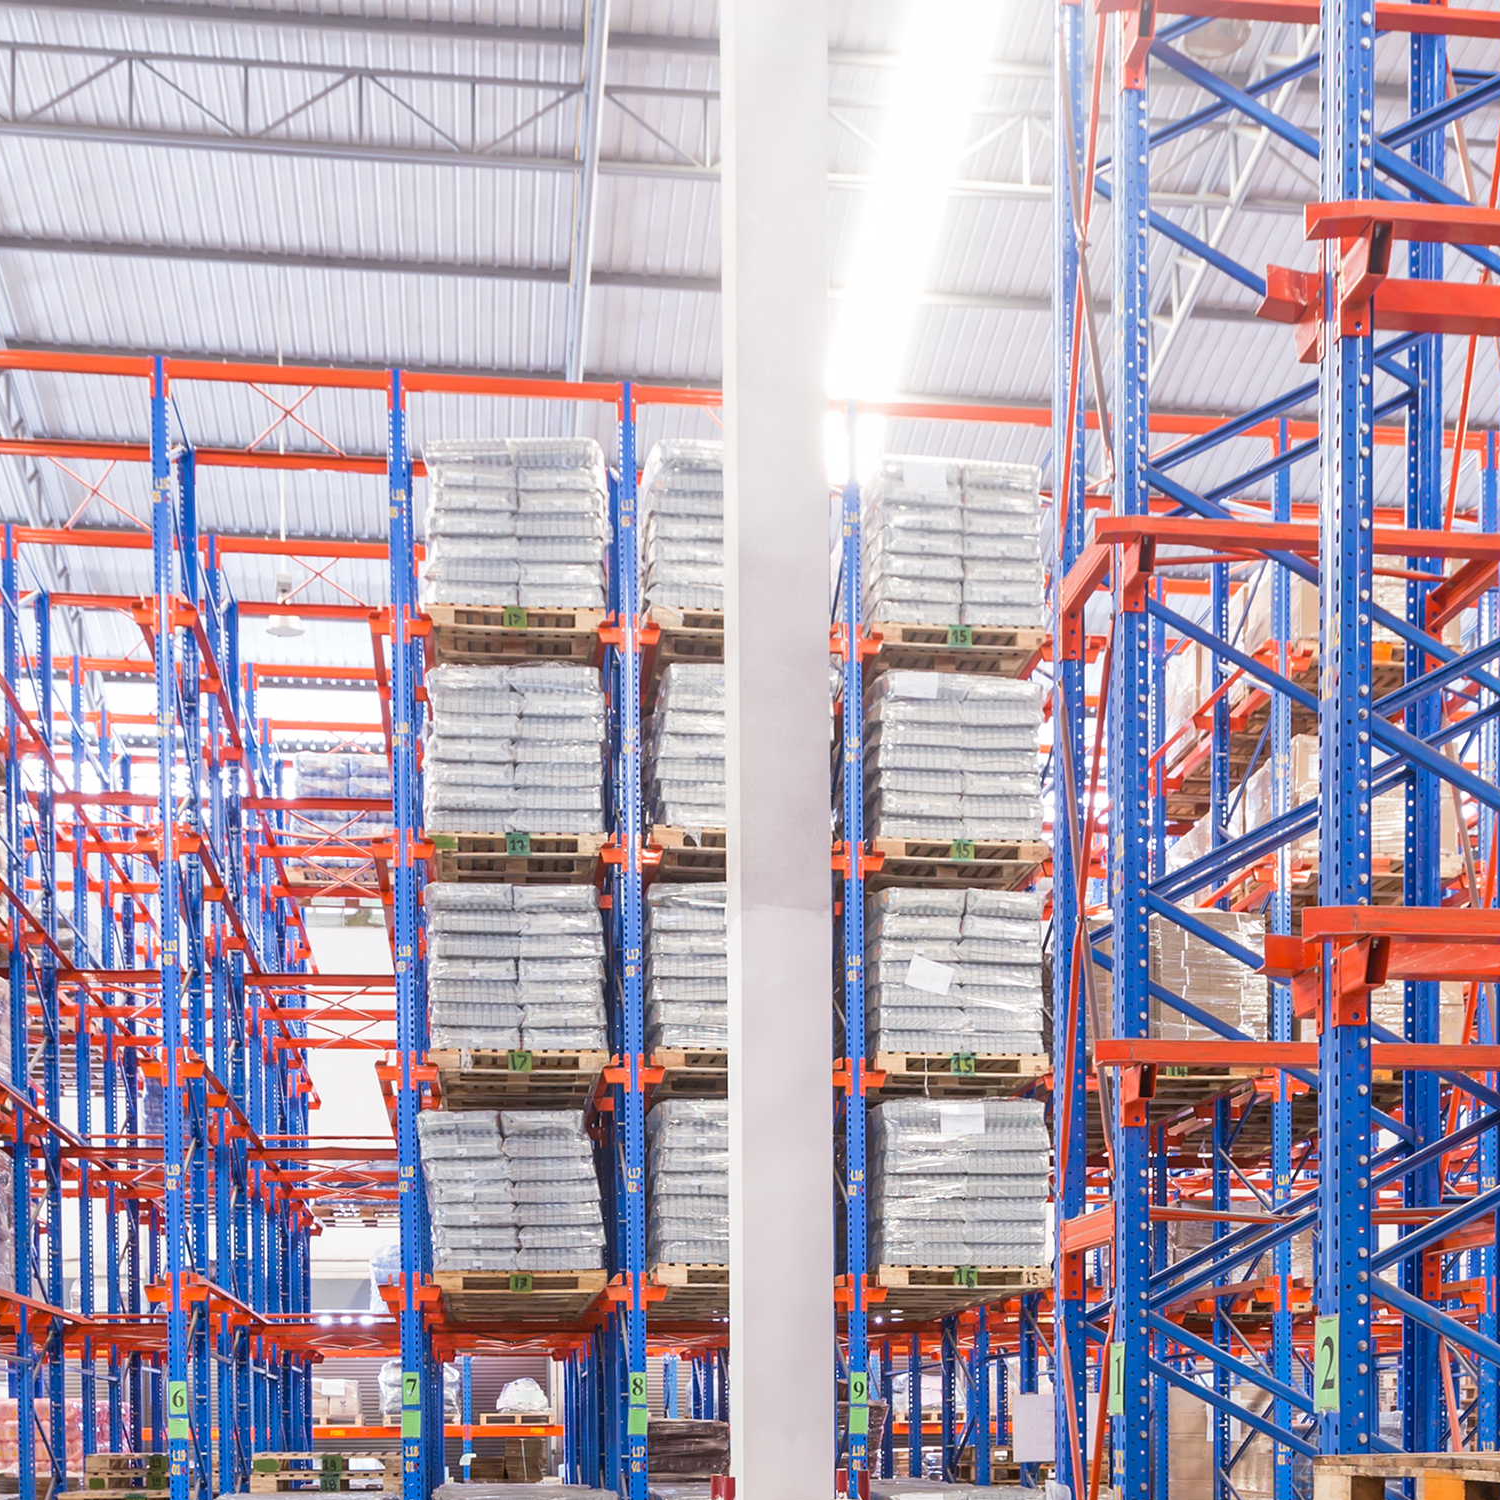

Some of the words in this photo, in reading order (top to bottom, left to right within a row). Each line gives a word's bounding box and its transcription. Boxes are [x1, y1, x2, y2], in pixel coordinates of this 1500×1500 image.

[952, 630, 967, 643] 15
[626, 948, 640, 960] L17
[511, 1054, 527, 1071] 17
[952, 1056, 973, 1073] 15
[166, 1163, 180, 1176] L19
[400, 1165, 414, 1178] L18
[628, 1167, 642, 1179] L17
[850, 1169, 864, 1181] L16
[1277, 1174, 1290, 1186] L14
[399, 1181, 409, 1193] 02
[627, 1181, 637, 1193] 02
[956, 1269, 975, 1287] 15
[1321, 1336, 1335, 1390] 2
[1115, 1356, 1122, 1395] 1
[405, 1378, 417, 1396] 7
[632, 1378, 644, 1396] 8
[853, 1381, 865, 1399] 9
[172, 1389, 184, 1408] 6
[173, 1449, 186, 1461] L19
[405, 1446, 419, 1458] L18
[632, 1446, 645, 1458] L17
[852, 1445, 865, 1456] L16
[852, 1460, 860, 1471] 01
[1277, 1454, 1286, 1466] 01
[172, 1463, 180, 1476] 01
[405, 1461, 414, 1473] 01
[632, 1461, 641, 1473] 01
